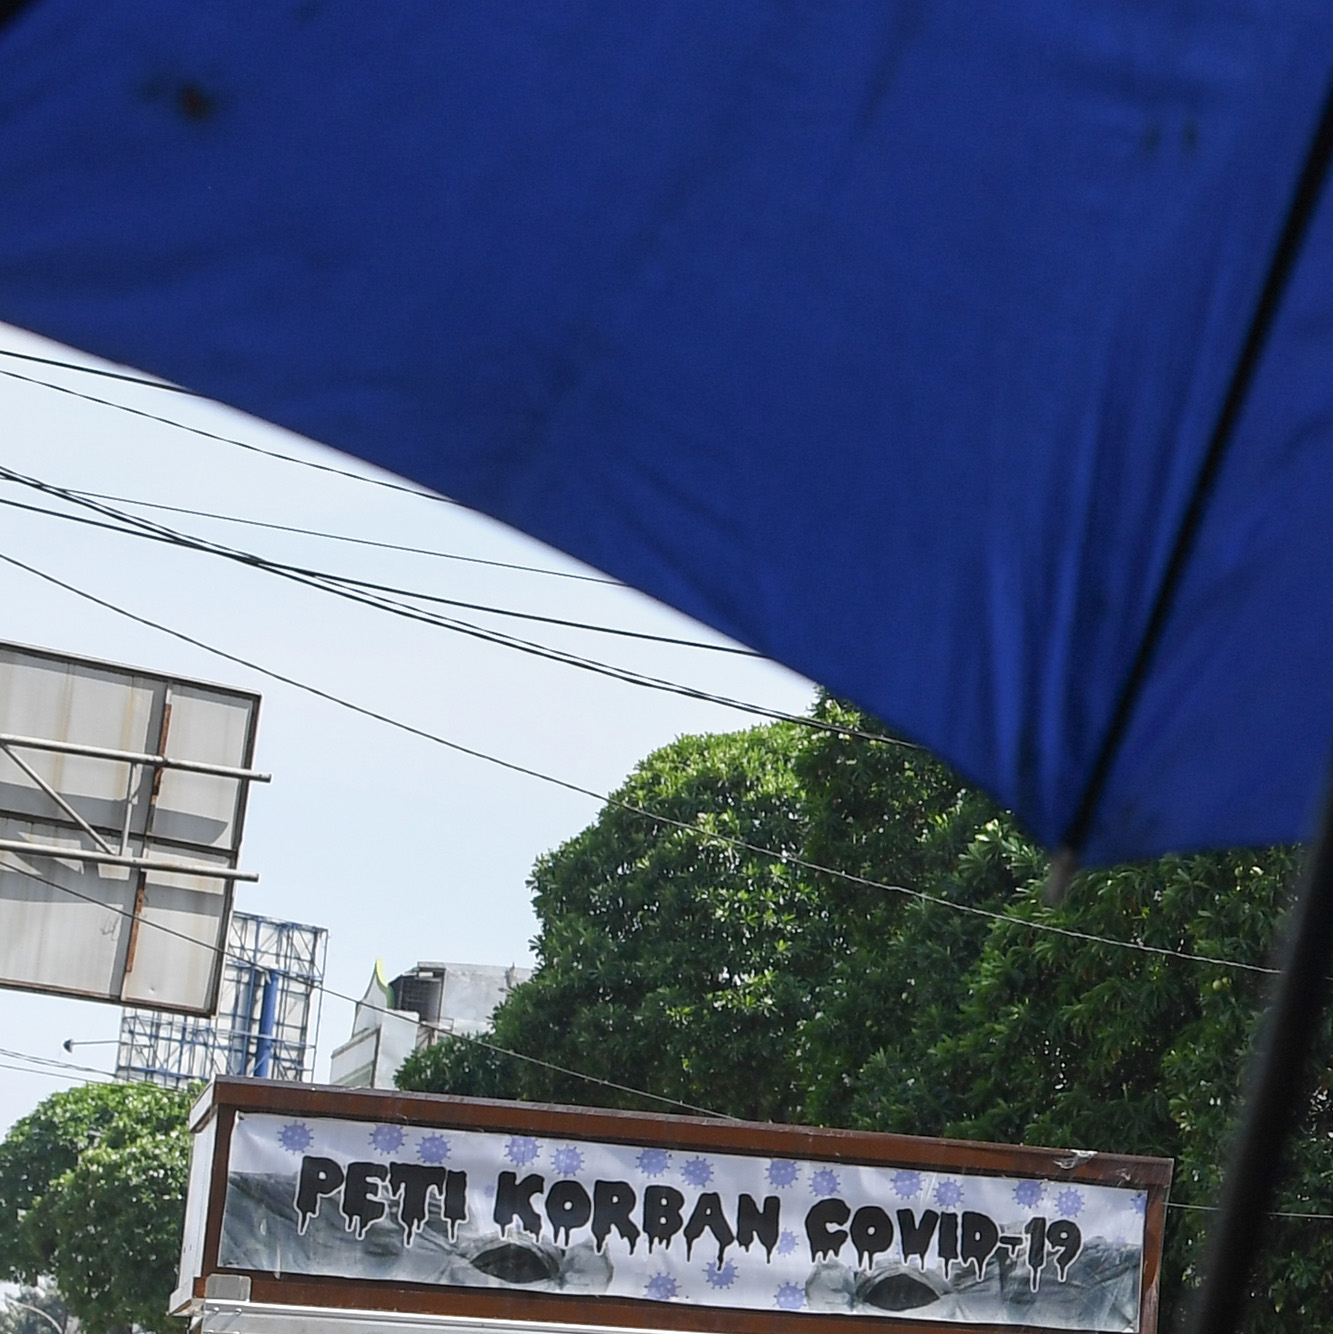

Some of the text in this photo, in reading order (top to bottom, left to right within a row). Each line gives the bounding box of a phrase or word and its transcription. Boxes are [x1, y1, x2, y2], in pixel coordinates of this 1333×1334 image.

[295, 1155, 1082, 1293] PETI KORBAN COVID-19
